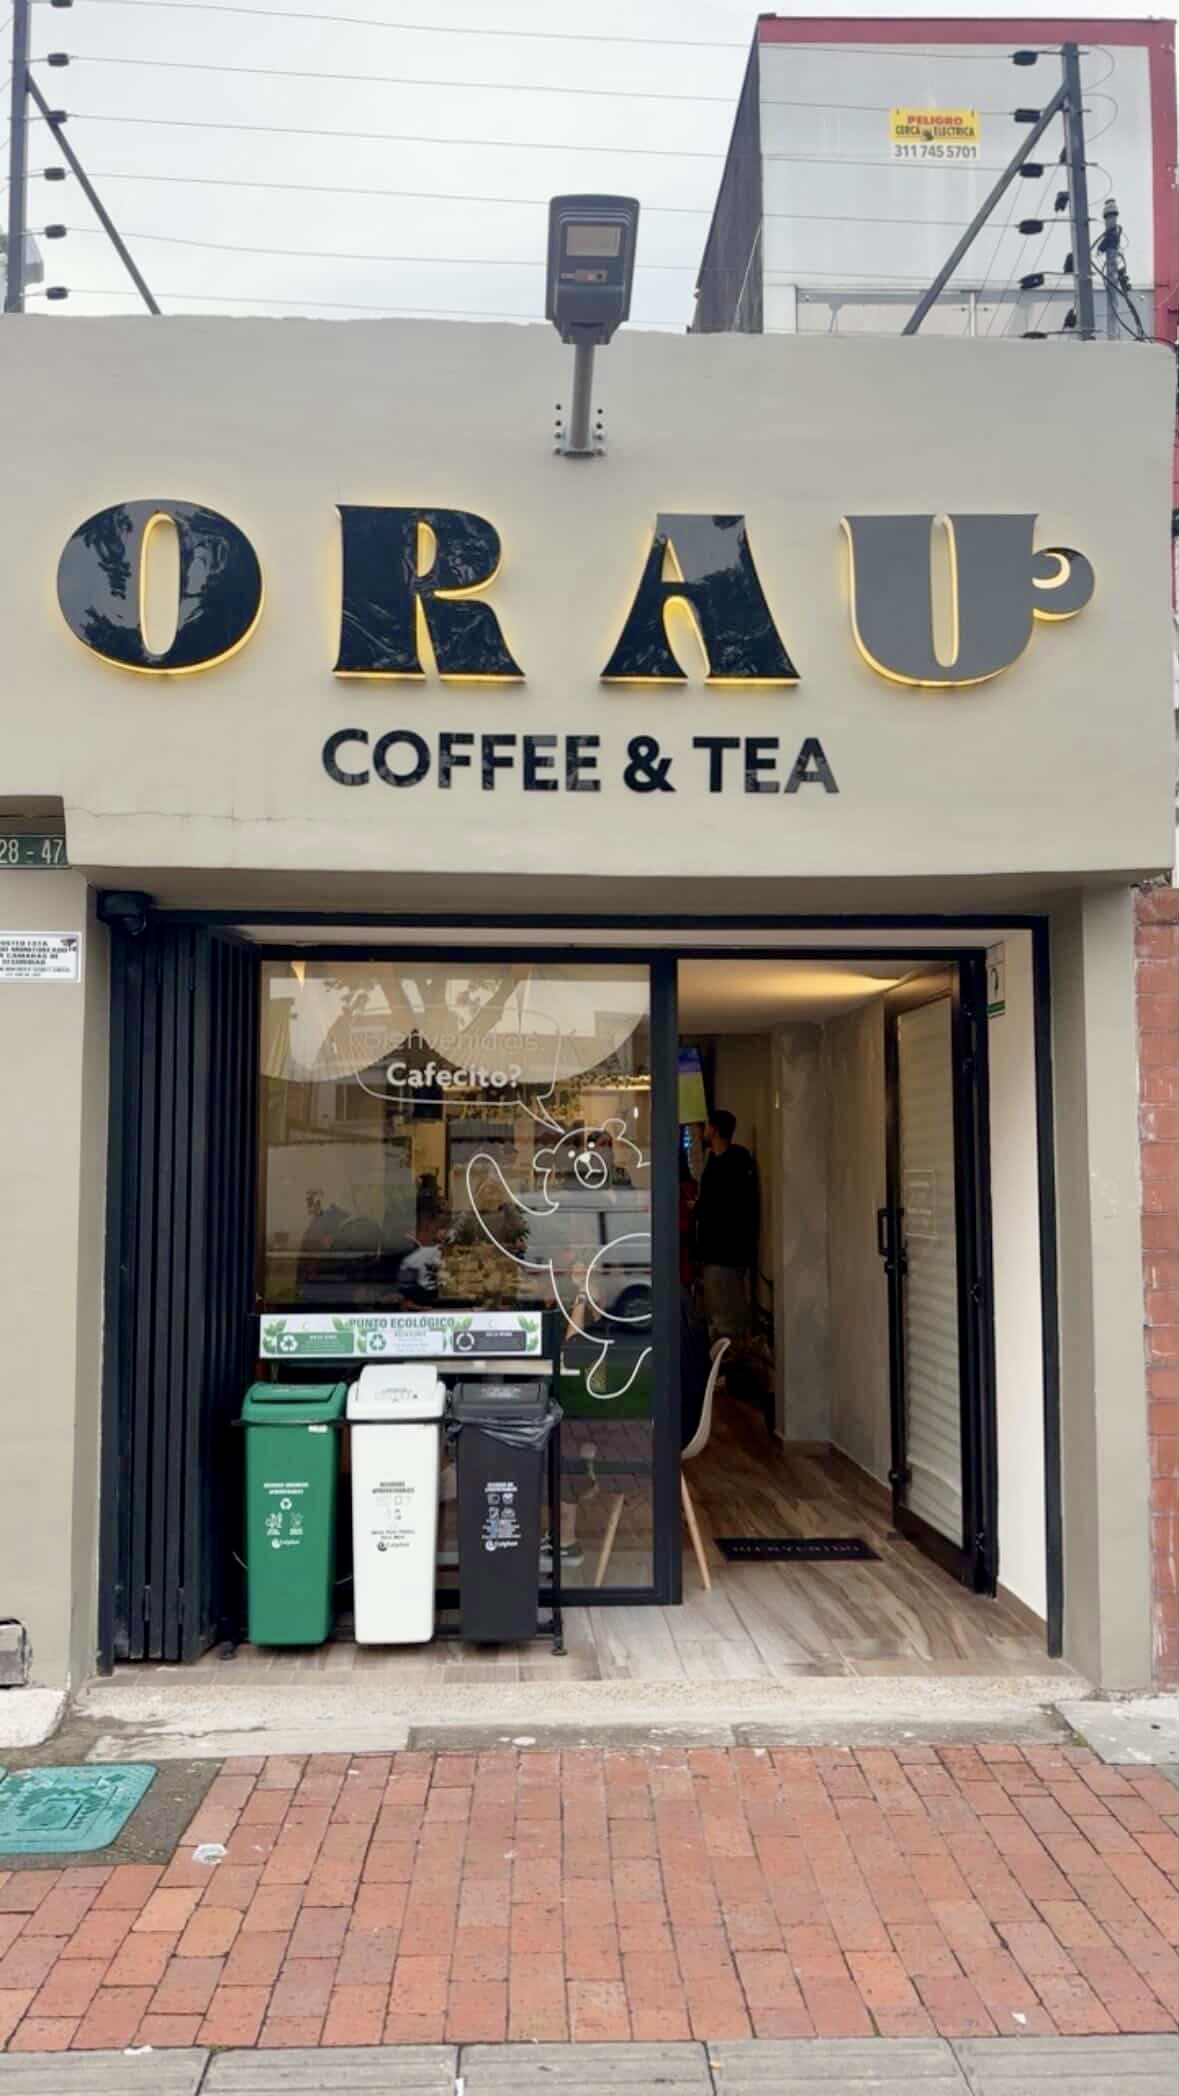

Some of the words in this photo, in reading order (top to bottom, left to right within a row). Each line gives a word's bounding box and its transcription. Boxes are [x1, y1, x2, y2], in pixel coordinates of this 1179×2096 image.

[907, 115, 963, 125] PELIGRO
[895, 126, 920, 135] CERCA
[933, 127, 975, 136] ELECTRICA
[895, 145, 917, 157] 311
[921, 146, 944, 158] 745
[946, 146, 976, 158] 5701
[57, 498, 1095, 686] ORAU
[322, 728, 600, 791] COFFEE
[624, 736, 672, 791] &
[693, 737, 838, 793] TEA
[41, 839, 63, 864] 47
[386, 1062, 521, 1087] Cafecito?
[349, 1318, 387, 1329] PUNTO
[391, 1316, 455, 1329] ECOLÓGICO
